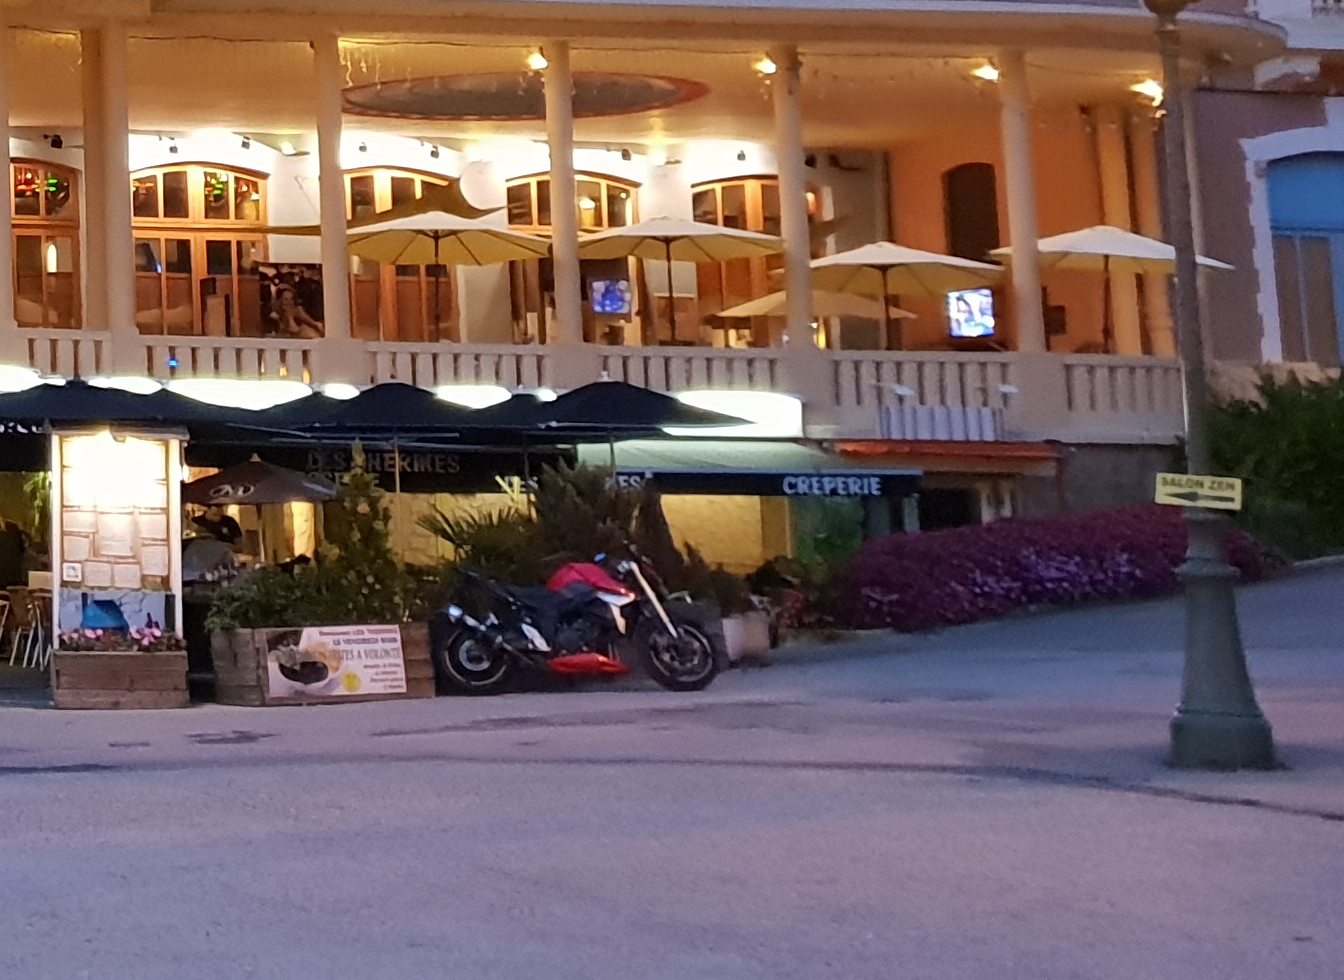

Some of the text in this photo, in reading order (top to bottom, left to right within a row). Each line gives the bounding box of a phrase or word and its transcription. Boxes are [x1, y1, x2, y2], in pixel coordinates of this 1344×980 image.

[782, 476, 882, 495] CREPERIE
[1161, 476, 1236, 491] SALON ZEN
